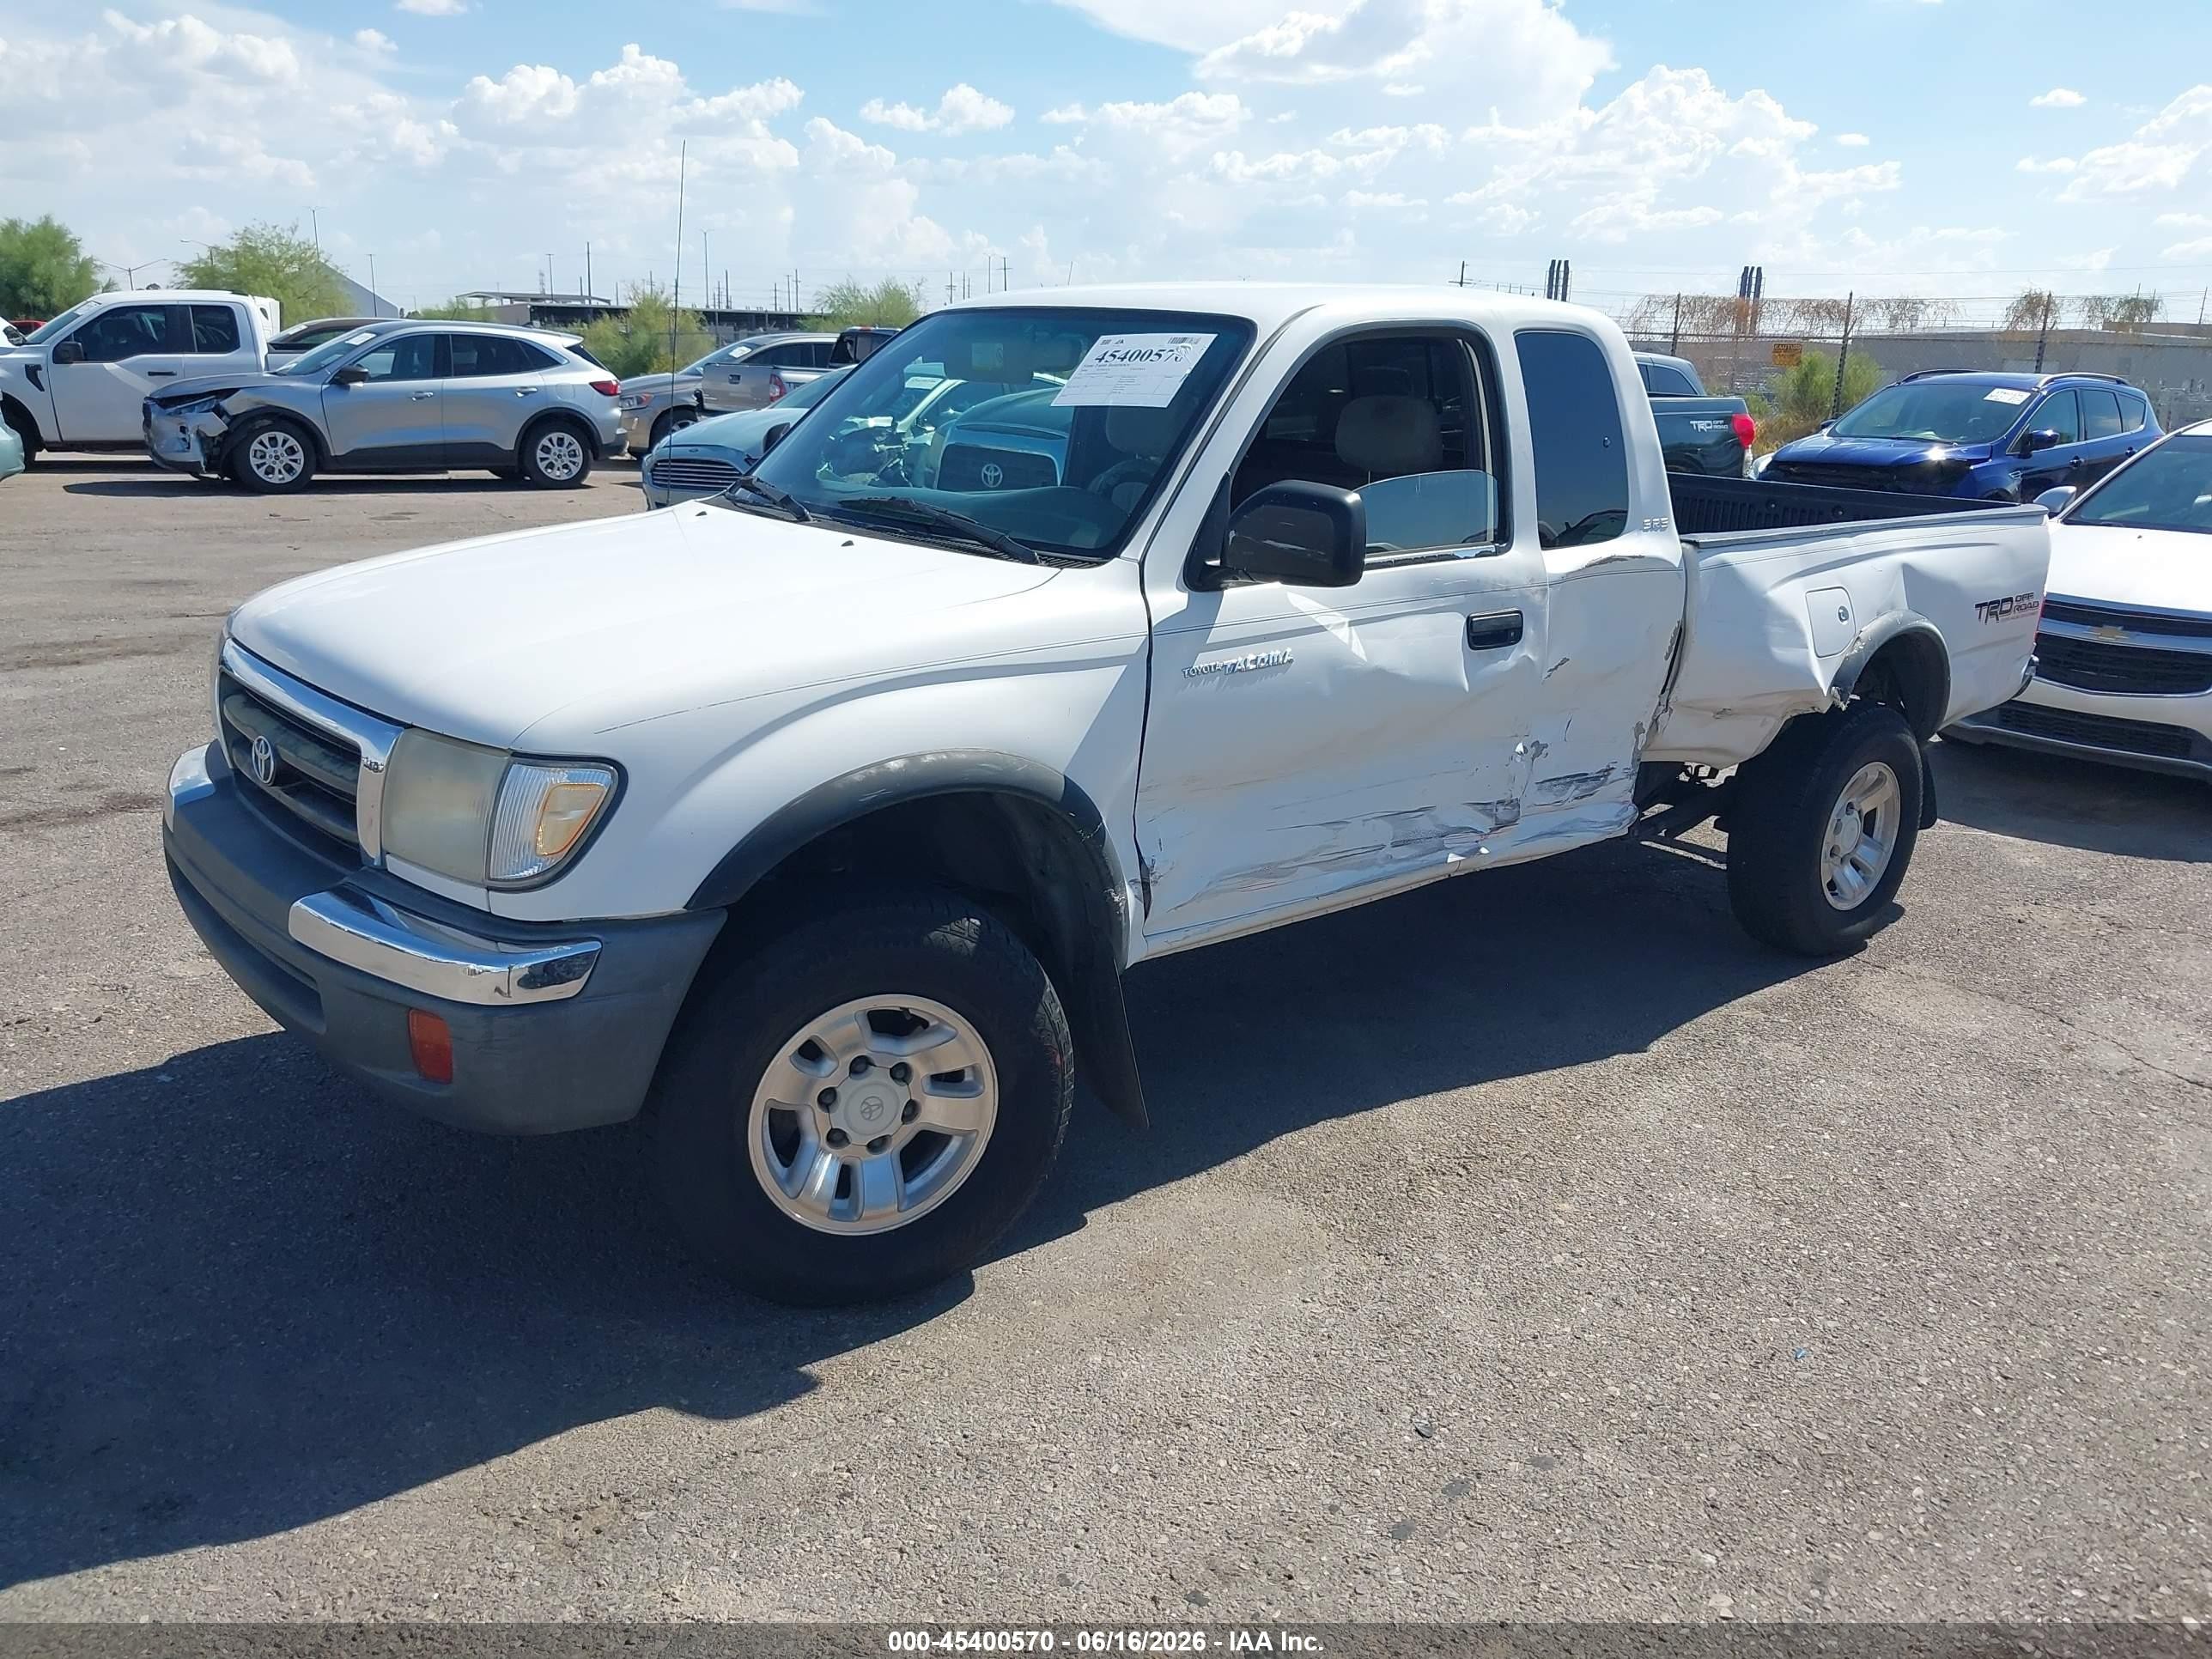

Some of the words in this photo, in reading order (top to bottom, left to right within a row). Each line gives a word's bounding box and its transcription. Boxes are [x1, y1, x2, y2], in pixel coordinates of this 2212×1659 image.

[1690, 421, 1712, 432] TRD
[1975, 597, 2014, 624] TRD
[2014, 592, 2033, 602] OFF
[2014, 601, 2039, 612] ROAD
[1182, 662, 1222, 678] TOYOTA
[1223, 648, 1294, 675] TACOMA
